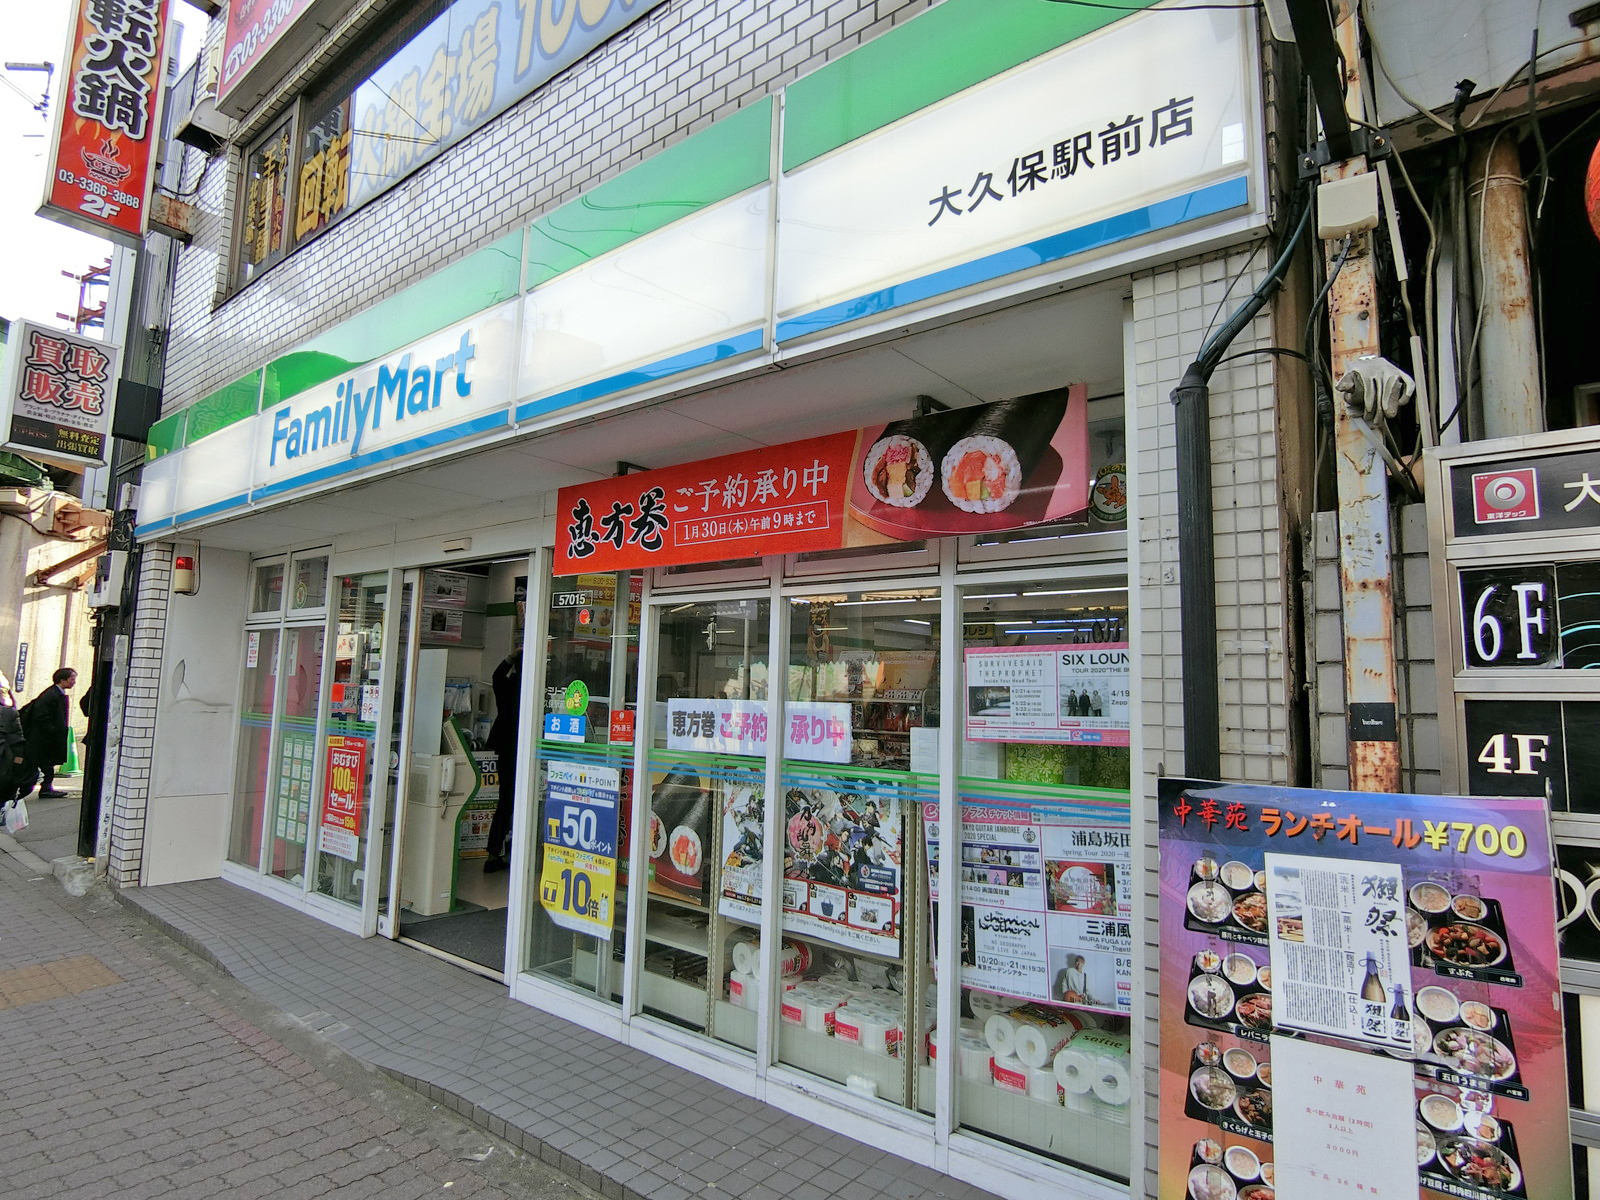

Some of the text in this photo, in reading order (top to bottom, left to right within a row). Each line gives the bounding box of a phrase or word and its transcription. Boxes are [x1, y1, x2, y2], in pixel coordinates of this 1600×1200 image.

[928, 95, 1194, 227] 大久保駅前店
[58, 168, 140, 209] 03-3366-3888
[79, 194, 121, 220] 2F
[28, 332, 108, 383] 買取
[22, 366, 105, 416] 販売
[269, 329, 475, 467] FamilyMart
[673, 459, 830, 513] ご予約承り中
[566, 487, 669, 559] 恵方巻
[1486, 510, 1527, 520] 東洋テック
[558, 593, 587, 606] 57015
[1062, 654, 1085, 666] SIX
[550, 716, 580, 735] お酒
[671, 710, 845, 747] 恵方巻 ご予約 承り中
[333, 751, 358, 768] おむすび
[1477, 733, 1550, 775] 4F
[588, 776, 617, 788] T-POINT
[330, 790, 354, 810] セール
[562, 805, 613, 855] 50 ポイント
[975, 824, 994, 832] GUITAR
[994, 825, 1020, 834] JAMBOREE
[1173, 797, 1250, 832] 中華苑
[1259, 807, 1422, 849] ランチオール
[1422, 819, 1527, 858] ¥700
[1062, 849, 1083, 857] Spring
[561, 868, 600, 919] 10 倍
[1079, 935, 1100, 943] MIURA
[1101, 937, 1119, 945] FUGA
[1086, 920, 1131, 938] 三浦風
[1447, 967, 1474, 978] すぶた
